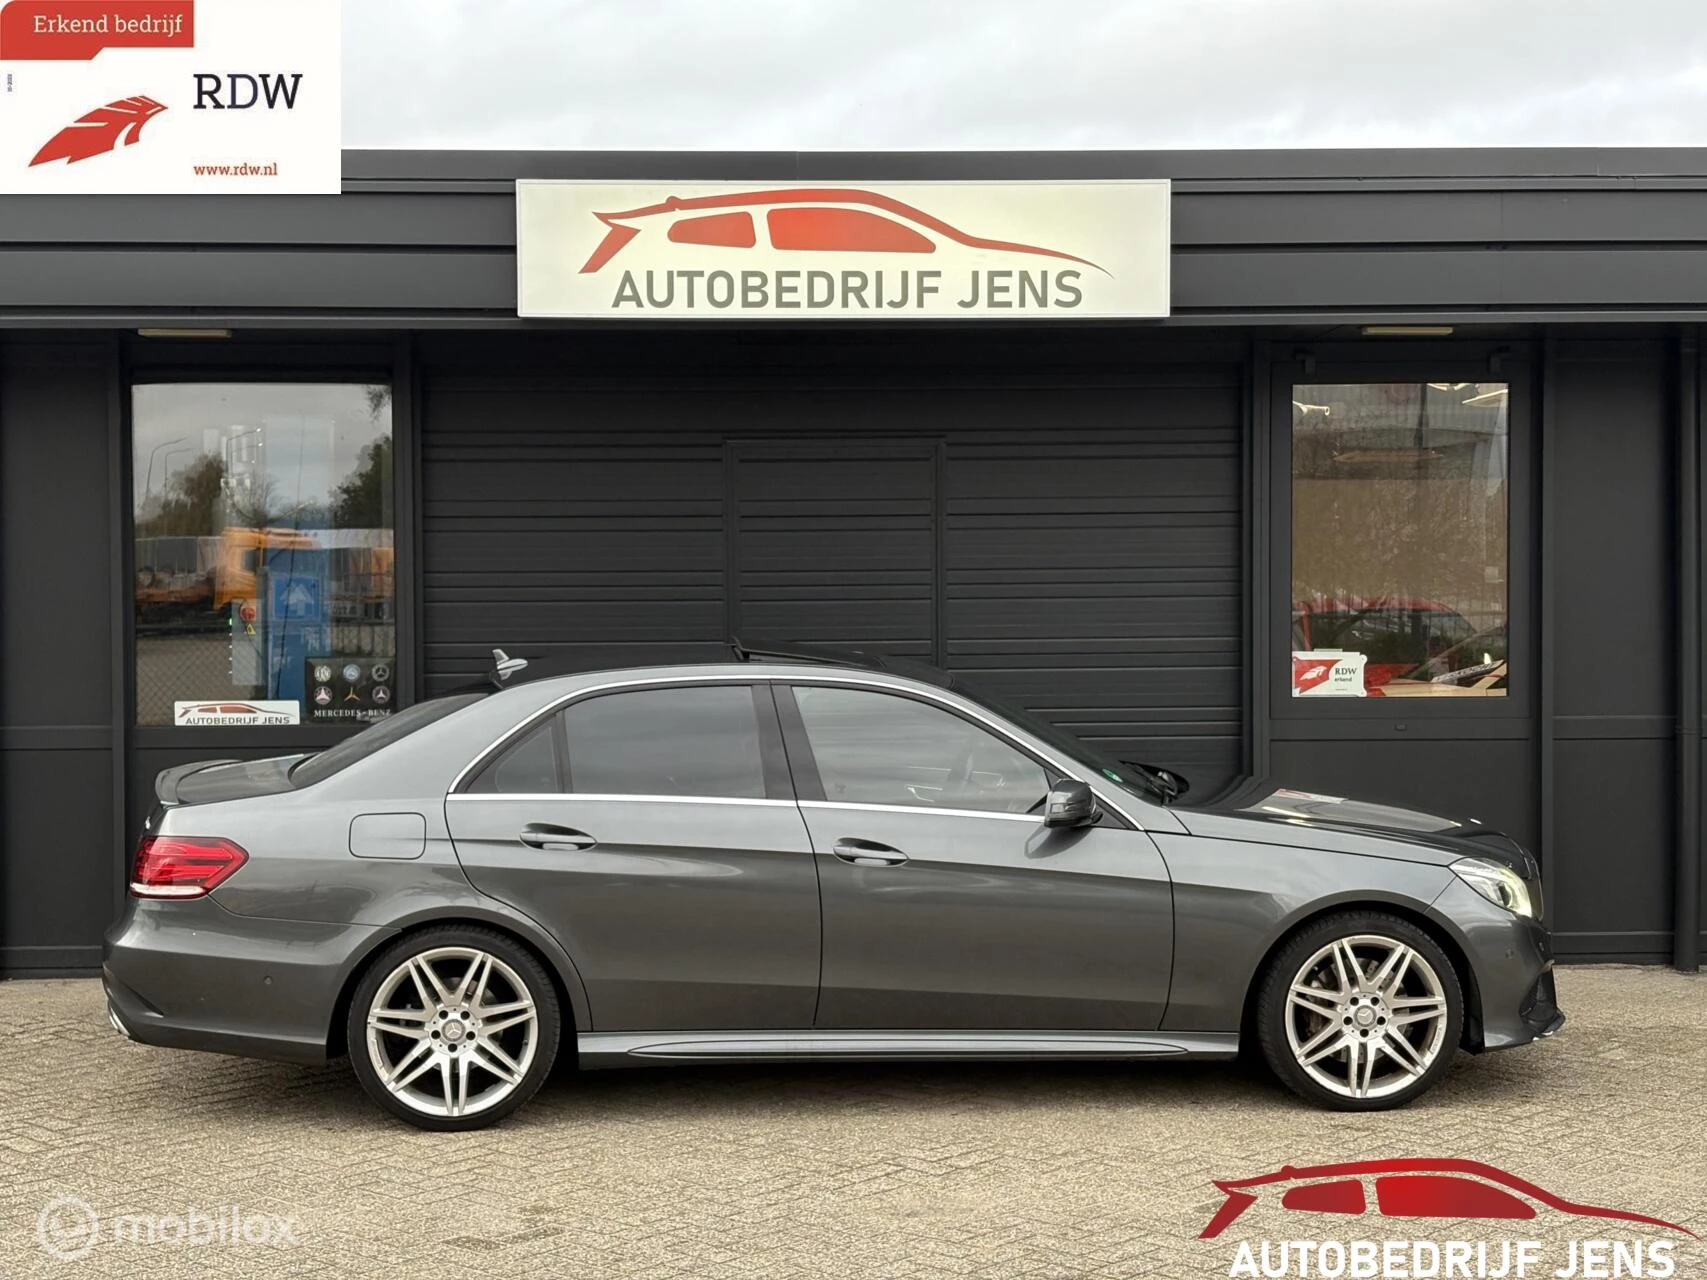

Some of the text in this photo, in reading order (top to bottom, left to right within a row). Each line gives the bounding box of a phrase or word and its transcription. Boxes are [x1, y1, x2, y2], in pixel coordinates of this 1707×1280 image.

[611, 270, 1083, 309] AUTOBEDRIJF JENS
[1335, 667, 1357, 675] RDW
[185, 716, 290, 725] AUTOBEDRIJF JENS
